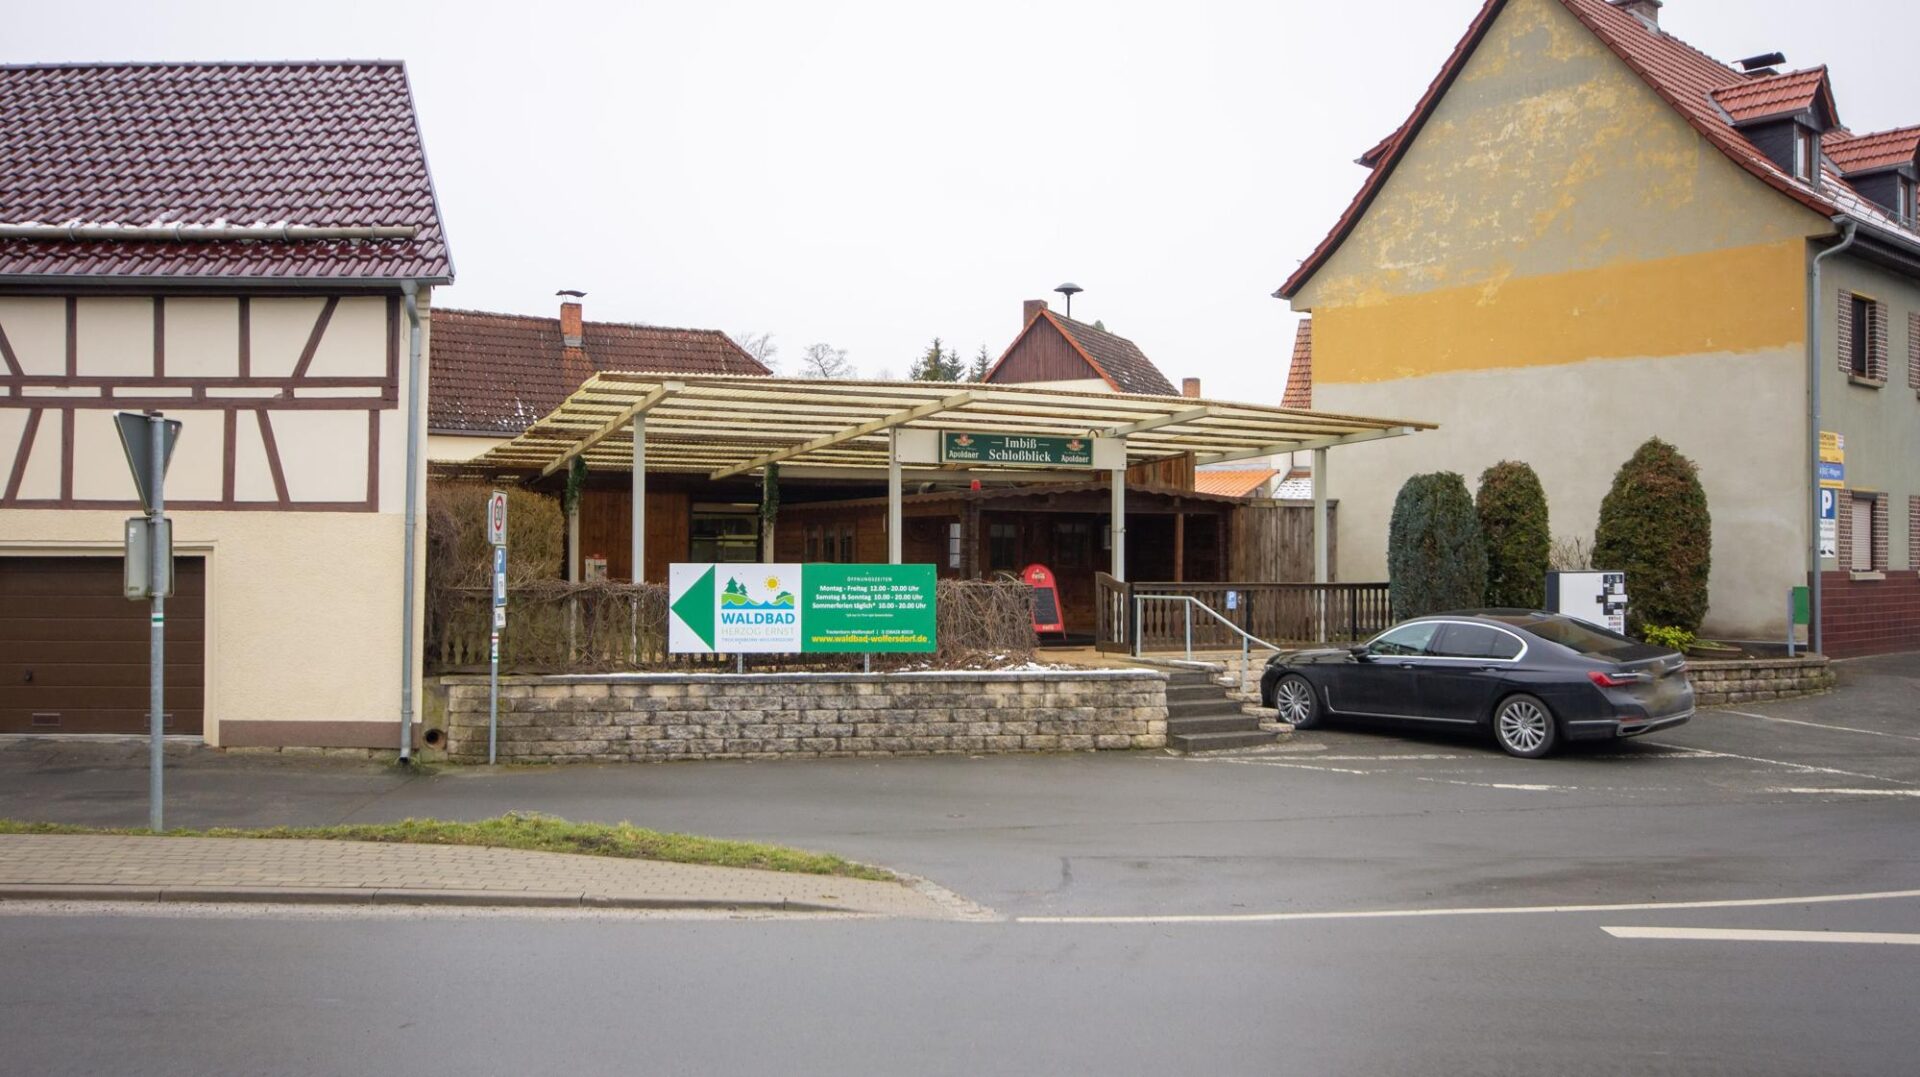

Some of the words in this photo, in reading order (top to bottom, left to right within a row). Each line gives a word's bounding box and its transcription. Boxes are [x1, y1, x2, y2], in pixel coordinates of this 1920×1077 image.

[1005, 437, 1037, 449] Imbiß
[949, 450, 980, 460] Apoldaer
[989, 449, 1051, 462] Schloßblick
[1061, 454, 1090, 464] Apoldaer
[1821, 489, 1832, 517] P
[820, 585, 843, 593] Montag
[847, 585, 867, 593] Freitag
[816, 594, 840, 602] Samstag
[847, 594, 871, 602] Sonntag
[721, 613, 795, 625] WALDBAD
[721, 627, 761, 636] HERZOG
[765, 627, 794, 636] ERNST
[811, 635, 928, 644] www.waldbad-wolfersdorf.de
